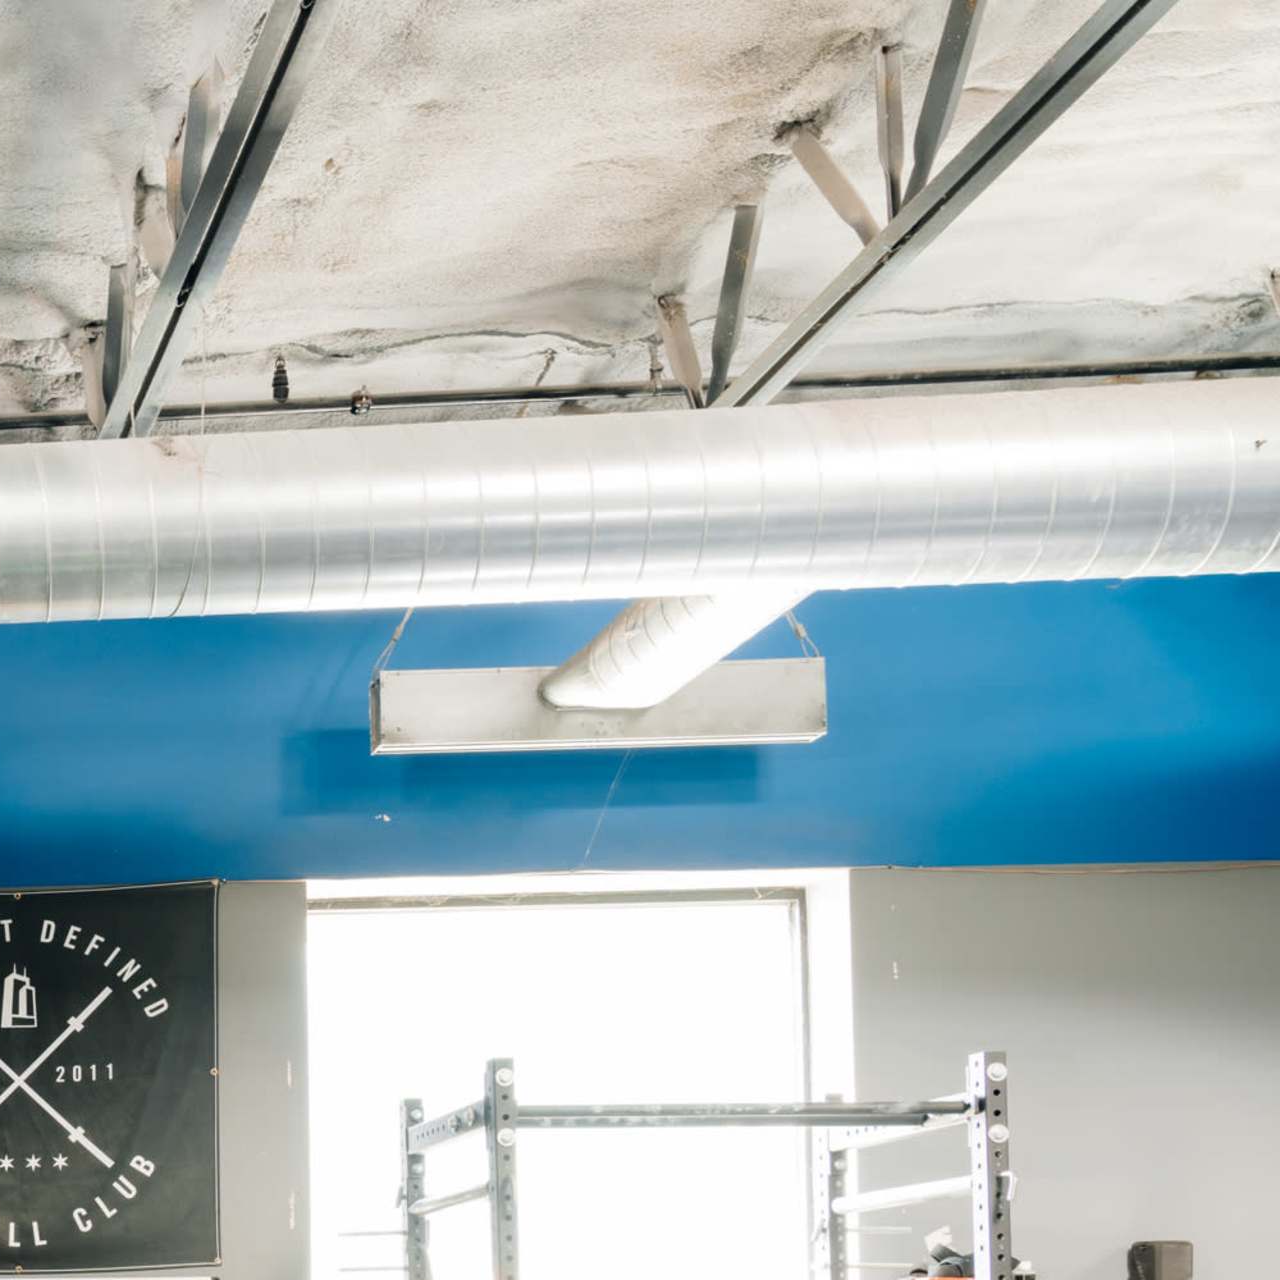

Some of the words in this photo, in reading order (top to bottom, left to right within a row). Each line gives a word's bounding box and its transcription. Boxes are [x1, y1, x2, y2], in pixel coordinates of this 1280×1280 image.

[40, 919, 169, 1018] DEFINED
[55, 1063, 114, 1083] 2011
[72, 1154, 155, 1233] CLUB
